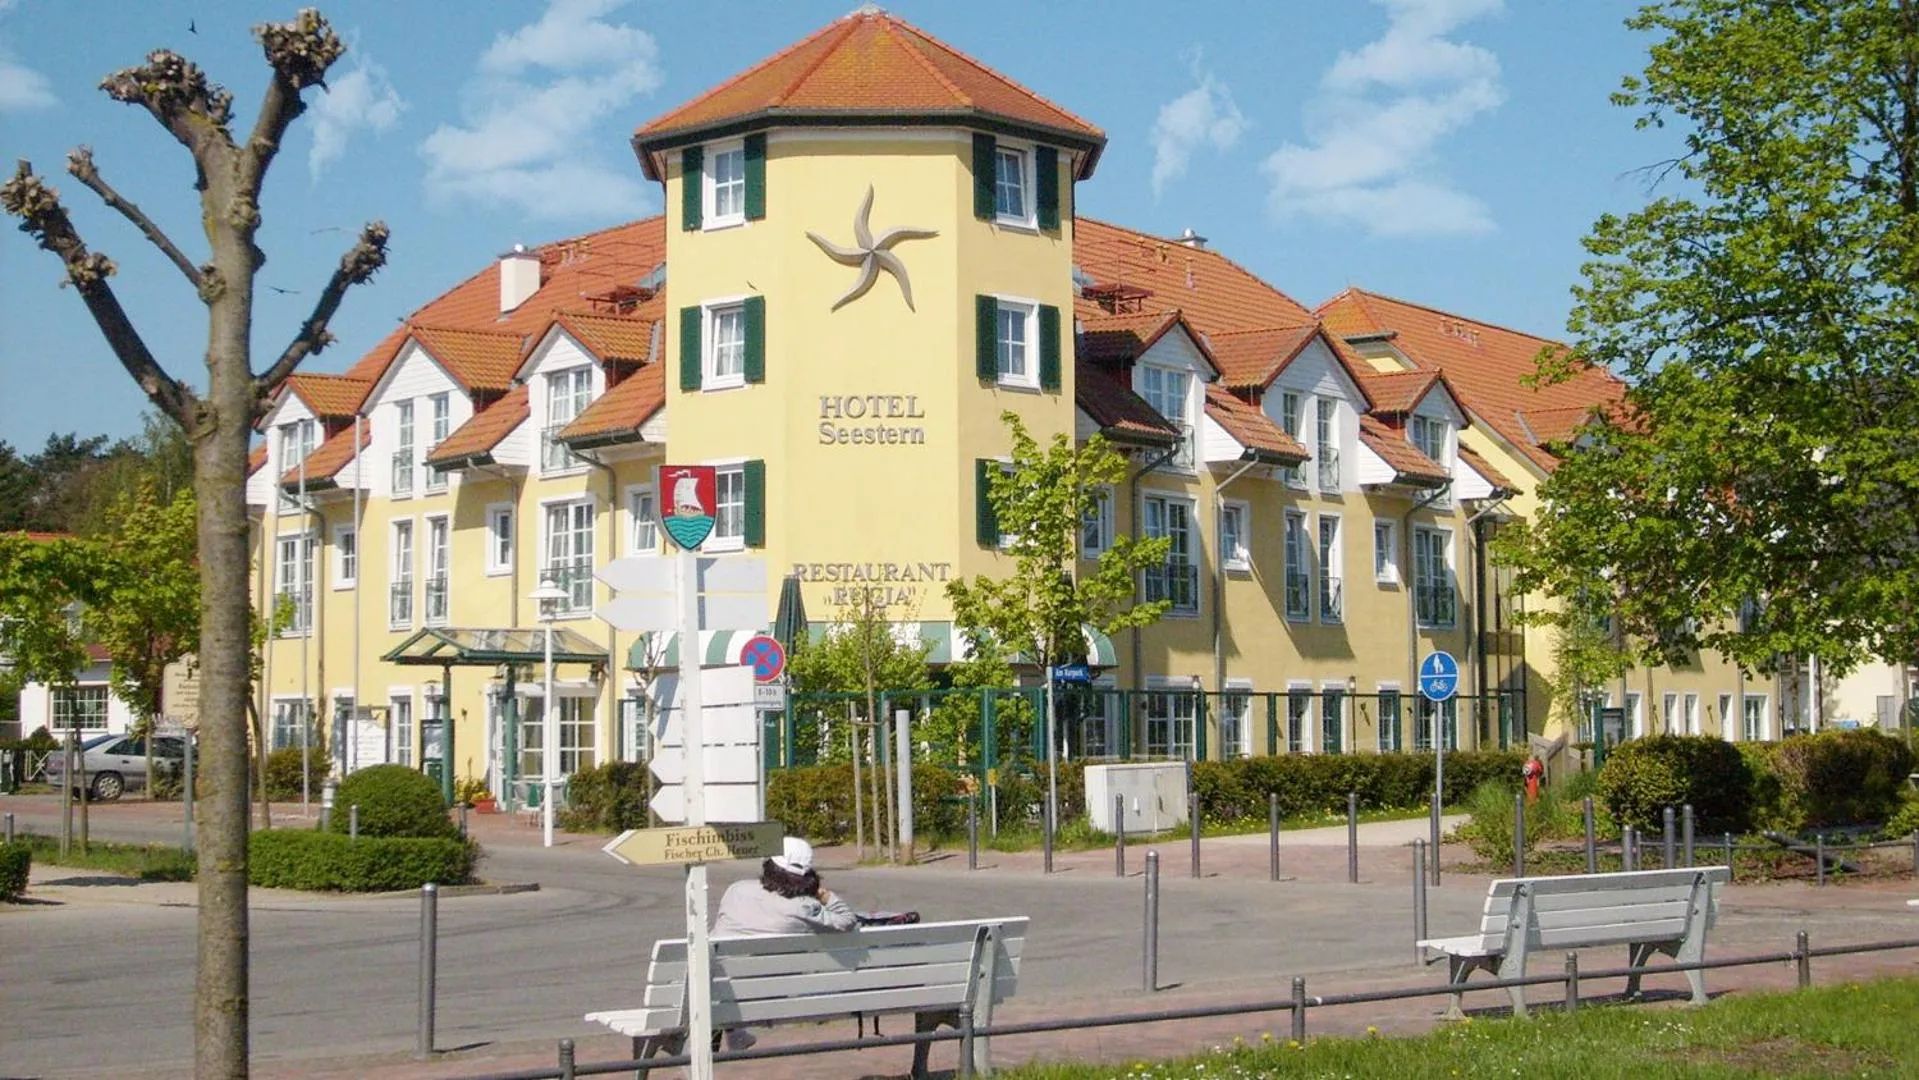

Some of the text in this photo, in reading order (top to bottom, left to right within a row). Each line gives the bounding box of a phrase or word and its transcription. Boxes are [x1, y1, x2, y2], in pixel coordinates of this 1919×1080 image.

[819, 395, 925, 419] HOTEL
[819, 421, 925, 445] Seestern
[792, 562, 951, 583] RESTAURANT
[665, 828, 756, 847] Fischimbiss
[664, 847, 702, 860] Fischer
[705, 846, 724, 858] Ch.
